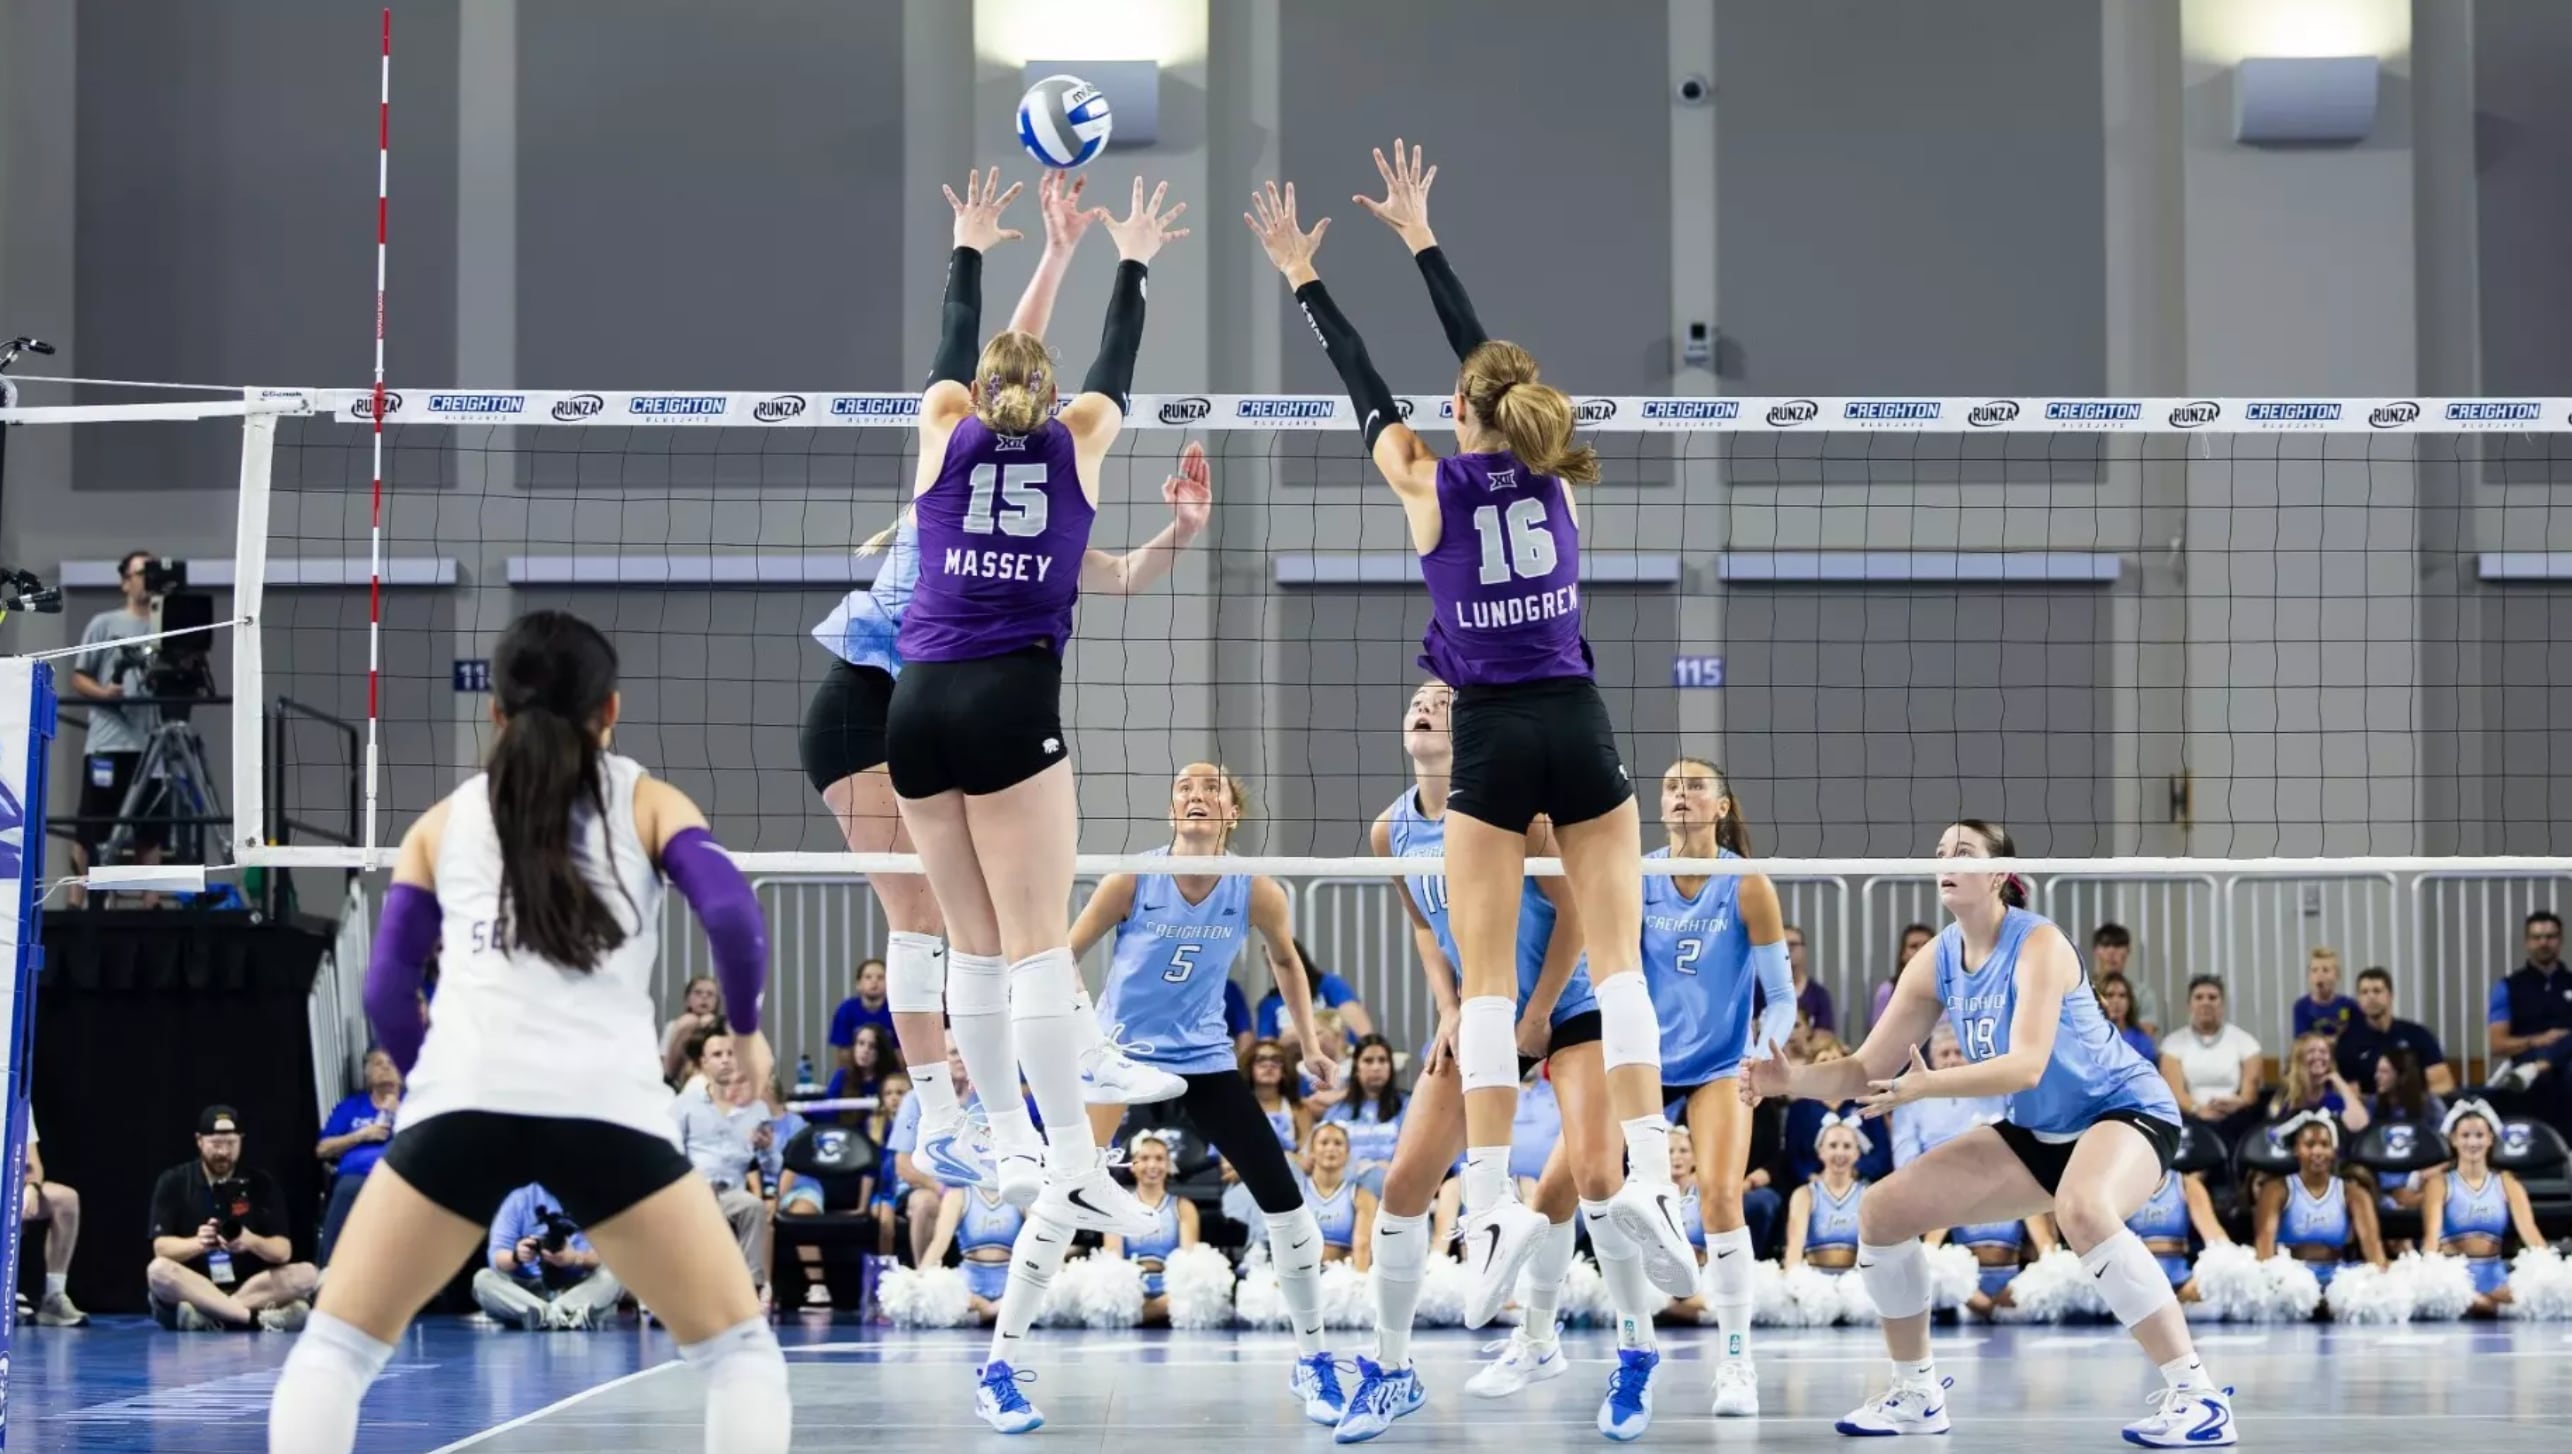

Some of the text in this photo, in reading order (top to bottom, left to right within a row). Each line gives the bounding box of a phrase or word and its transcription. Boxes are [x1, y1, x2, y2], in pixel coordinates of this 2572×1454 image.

[356, 399, 397, 413] RUZA
[428, 395, 525, 412] CREIGHTON
[556, 402, 599, 416] RUNZA
[629, 397, 727, 414] CREIGHTON
[758, 402, 800, 417] RUNZA
[1163, 404, 1206, 419] RUNZA
[1236, 400, 1335, 418] CREIGHTON
[1642, 401, 1739, 418] CREIGHTON
[1844, 402, 1941, 419] CREIGHTON
[2045, 403, 2143, 420] CREIGHTON
[2245, 403, 2343, 420] CREIGHTON
[2445, 403, 2542, 420] CREIGHTON
[1771, 406, 1814, 421] RUNZA
[1973, 406, 2015, 422] RUNZA
[2173, 407, 2216, 423] RUNZA
[2373, 408, 2416, 423] RUNZA
[963, 463, 1048, 537] 15
[1473, 497, 1558, 585] 16
[944, 548, 1053, 582] MASSEY
[1674, 659, 1721, 686] 115
[1645, 915, 1728, 933] CREIGHTON
[1162, 944, 1202, 983] 5
[1675, 938, 1702, 975] 2
[1962, 1016, 1997, 1061] 19
